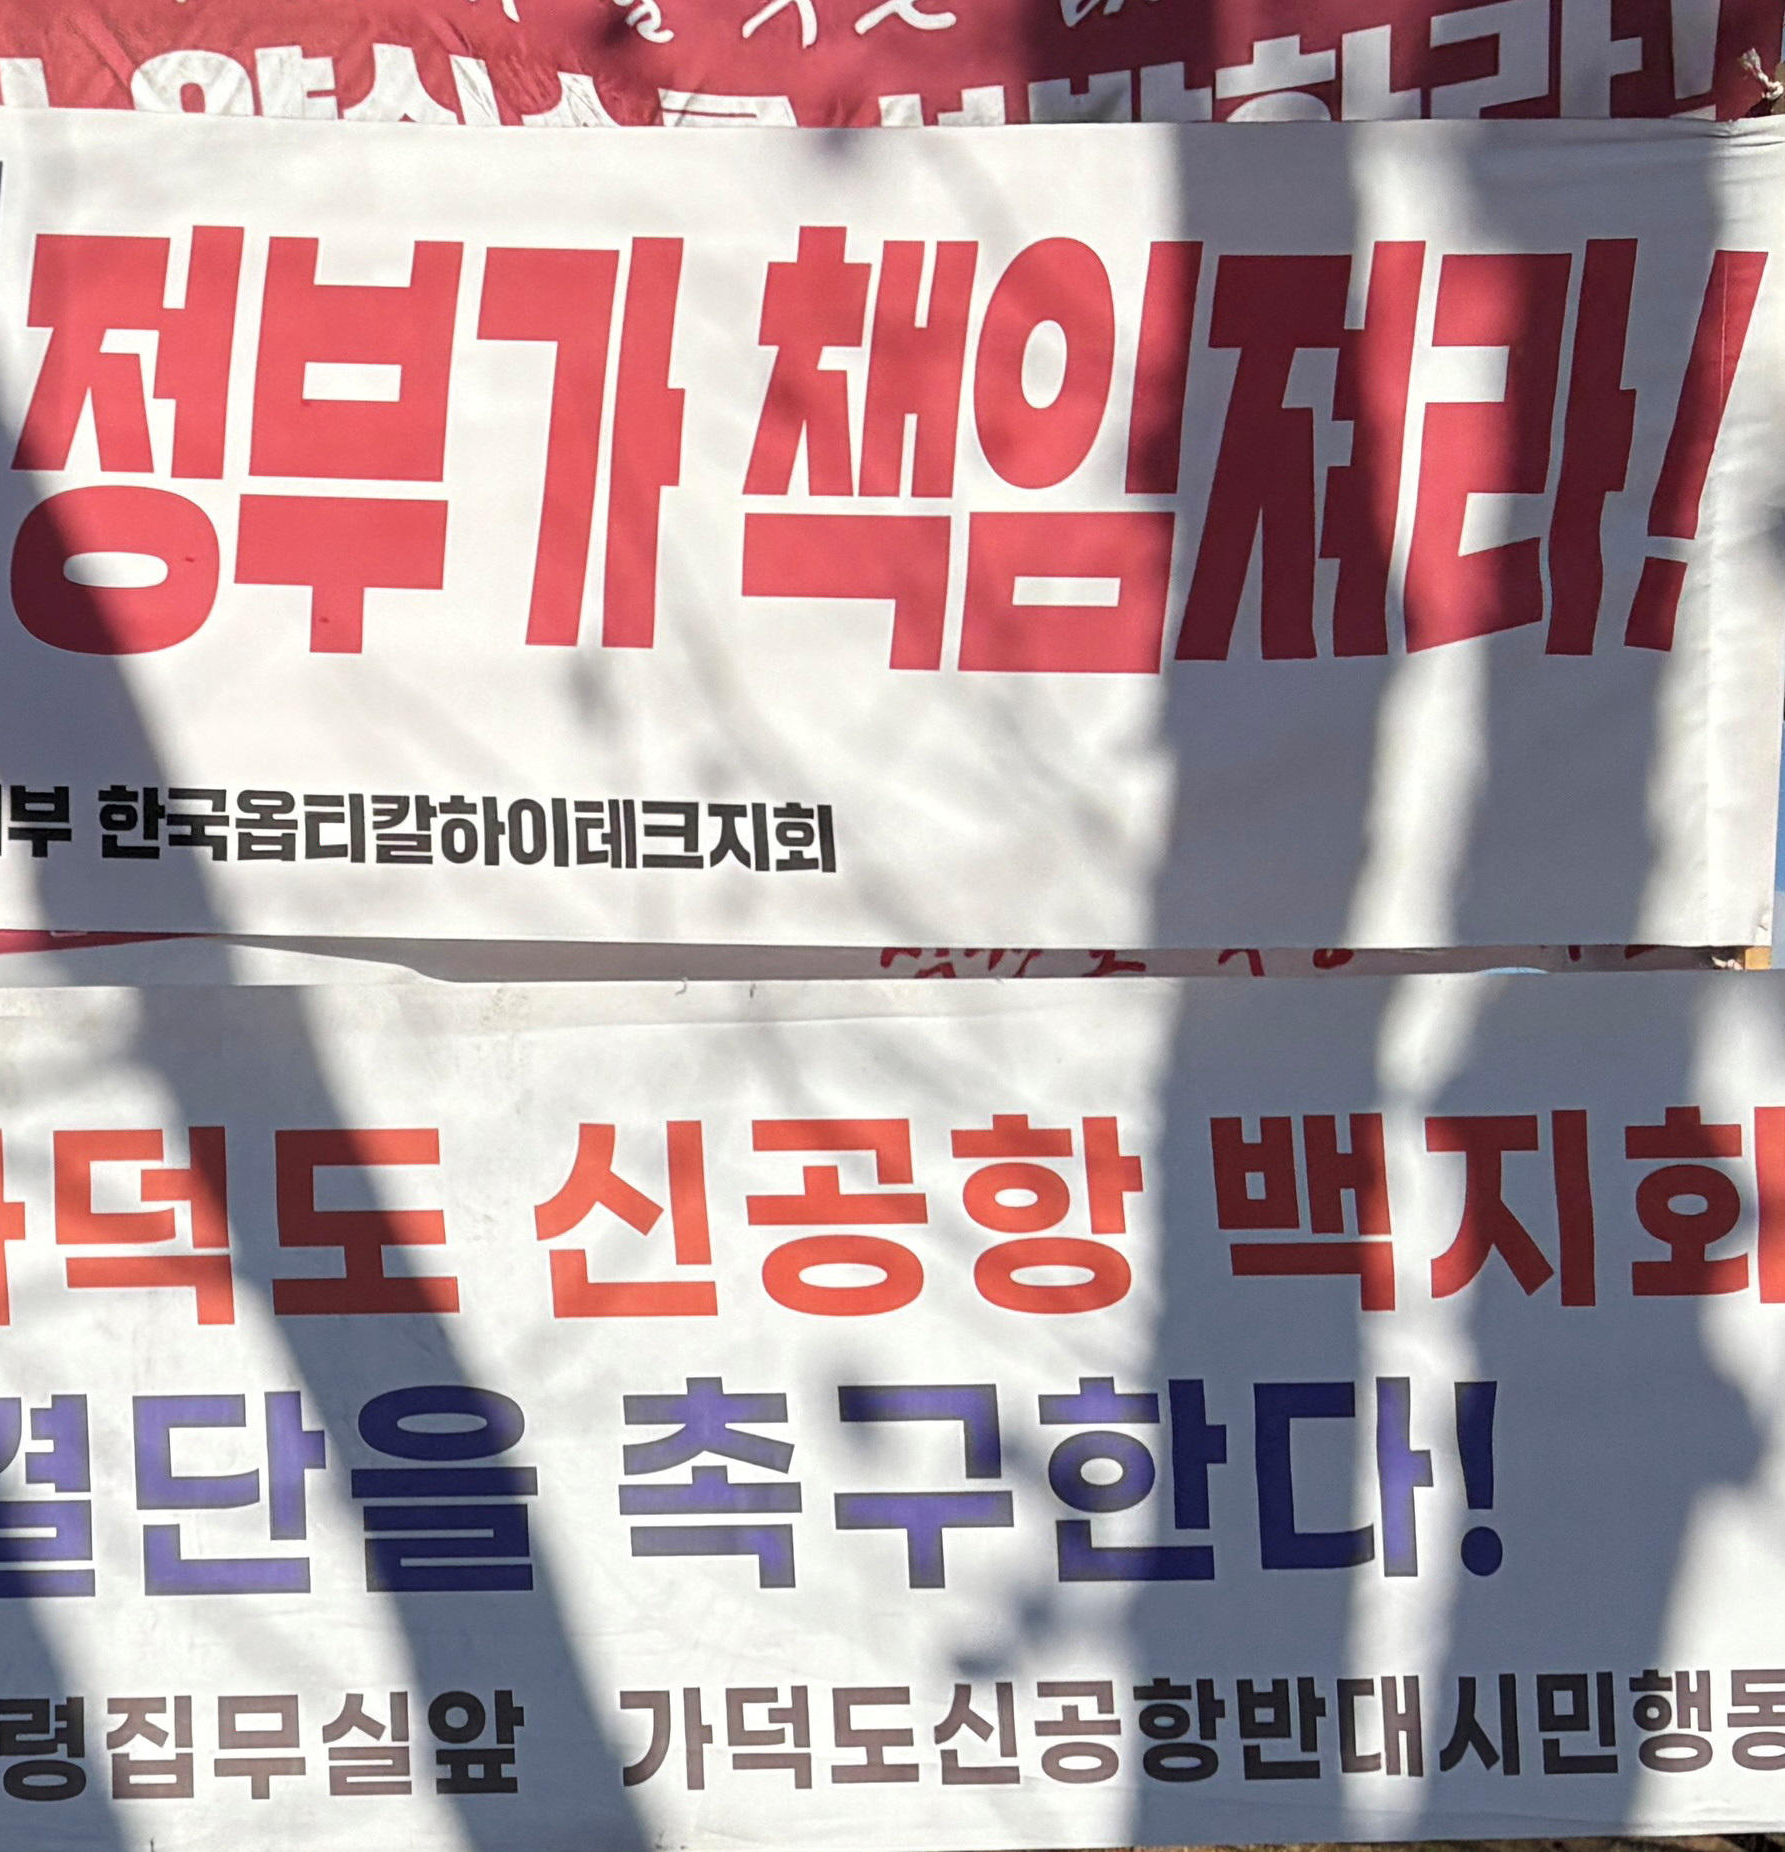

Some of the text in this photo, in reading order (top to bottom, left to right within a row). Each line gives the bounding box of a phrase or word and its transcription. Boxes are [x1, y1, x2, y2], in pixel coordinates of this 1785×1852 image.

[11, 225, 1769, 675] 정부가 책임져라!
[97, 783, 837, 874] 한국옵티칼하이테크지회
[533, 1110, 1143, 1320] 신공항
[618, 1375, 1506, 1592] 촉구한다!
[617, 1667, 1785, 1790] 가덕도신공항반대시민행동
